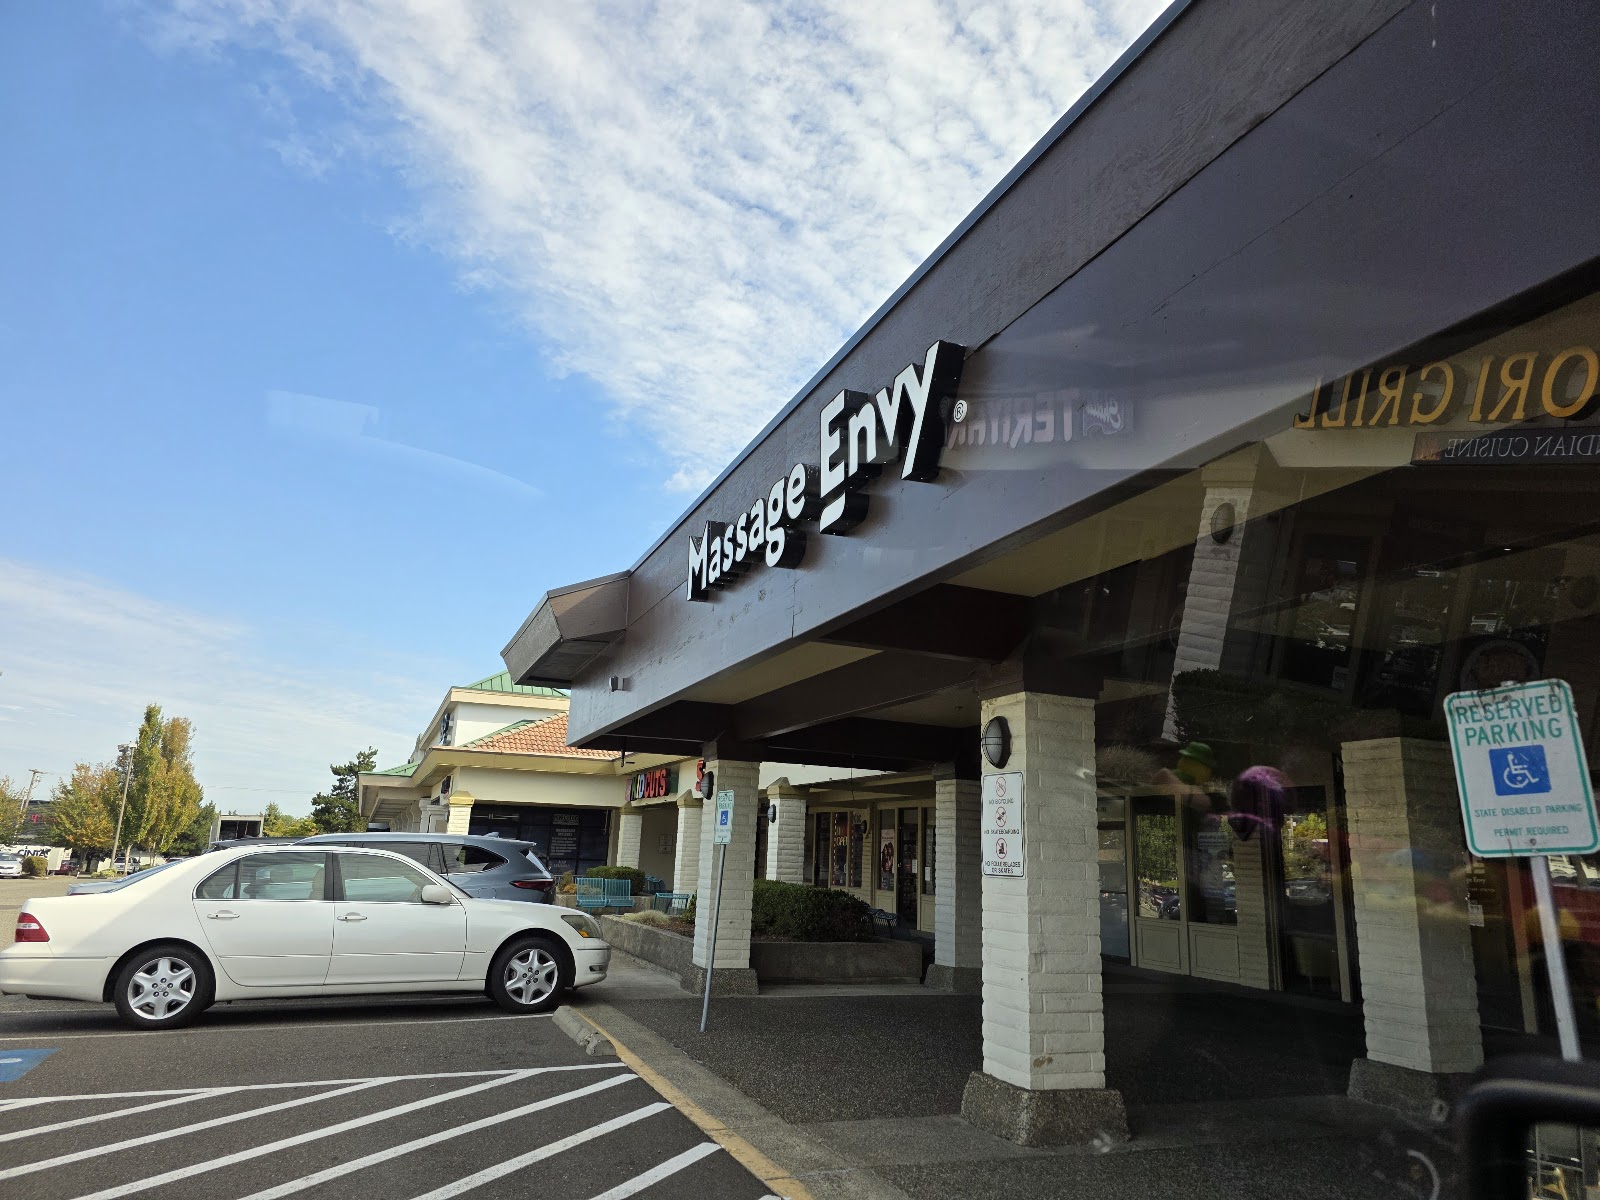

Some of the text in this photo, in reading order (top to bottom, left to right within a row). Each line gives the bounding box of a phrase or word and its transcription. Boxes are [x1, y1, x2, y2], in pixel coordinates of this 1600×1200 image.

[687, 463, 806, 601] Massage
[819, 340, 941, 534] Envy
[1455, 694, 1563, 725] RESERVED
[1464, 718, 1563, 746] PARKING
[1475, 803, 1583, 818] STATE DISABLED PARKING
[1494, 825, 1570, 837] PERMIT REQUIRED
